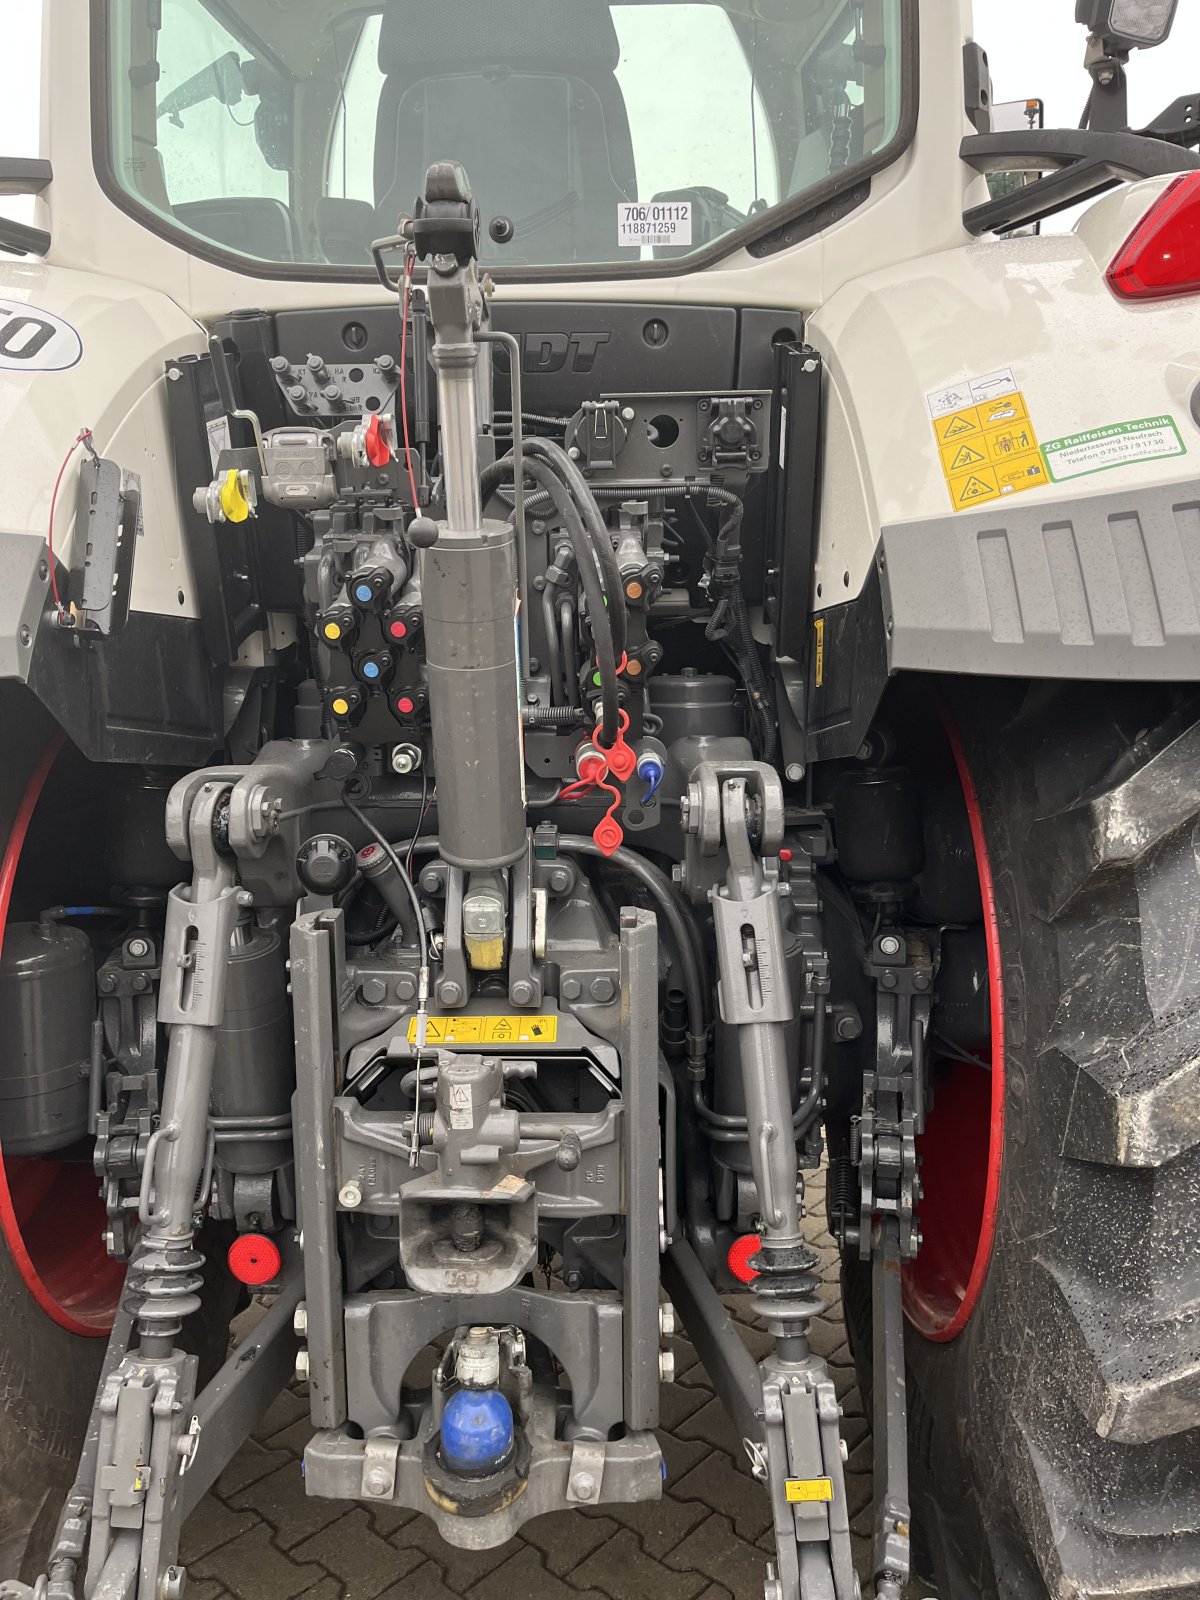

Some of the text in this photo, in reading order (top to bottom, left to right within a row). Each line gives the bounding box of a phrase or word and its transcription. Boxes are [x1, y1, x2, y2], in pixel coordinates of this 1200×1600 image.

[624, 206, 688, 221] 706/ 01112
[621, 222, 676, 234] 118871259
[0, 308, 57, 360] 0
[1044, 441, 1062, 452] ZG
[1064, 427, 1123, 447] Raiffeisen
[1124, 418, 1171, 432] Technik
[1059, 430, 1163, 459] Niederlassung Neufrach
[1066, 453, 1098, 465] Telefon
